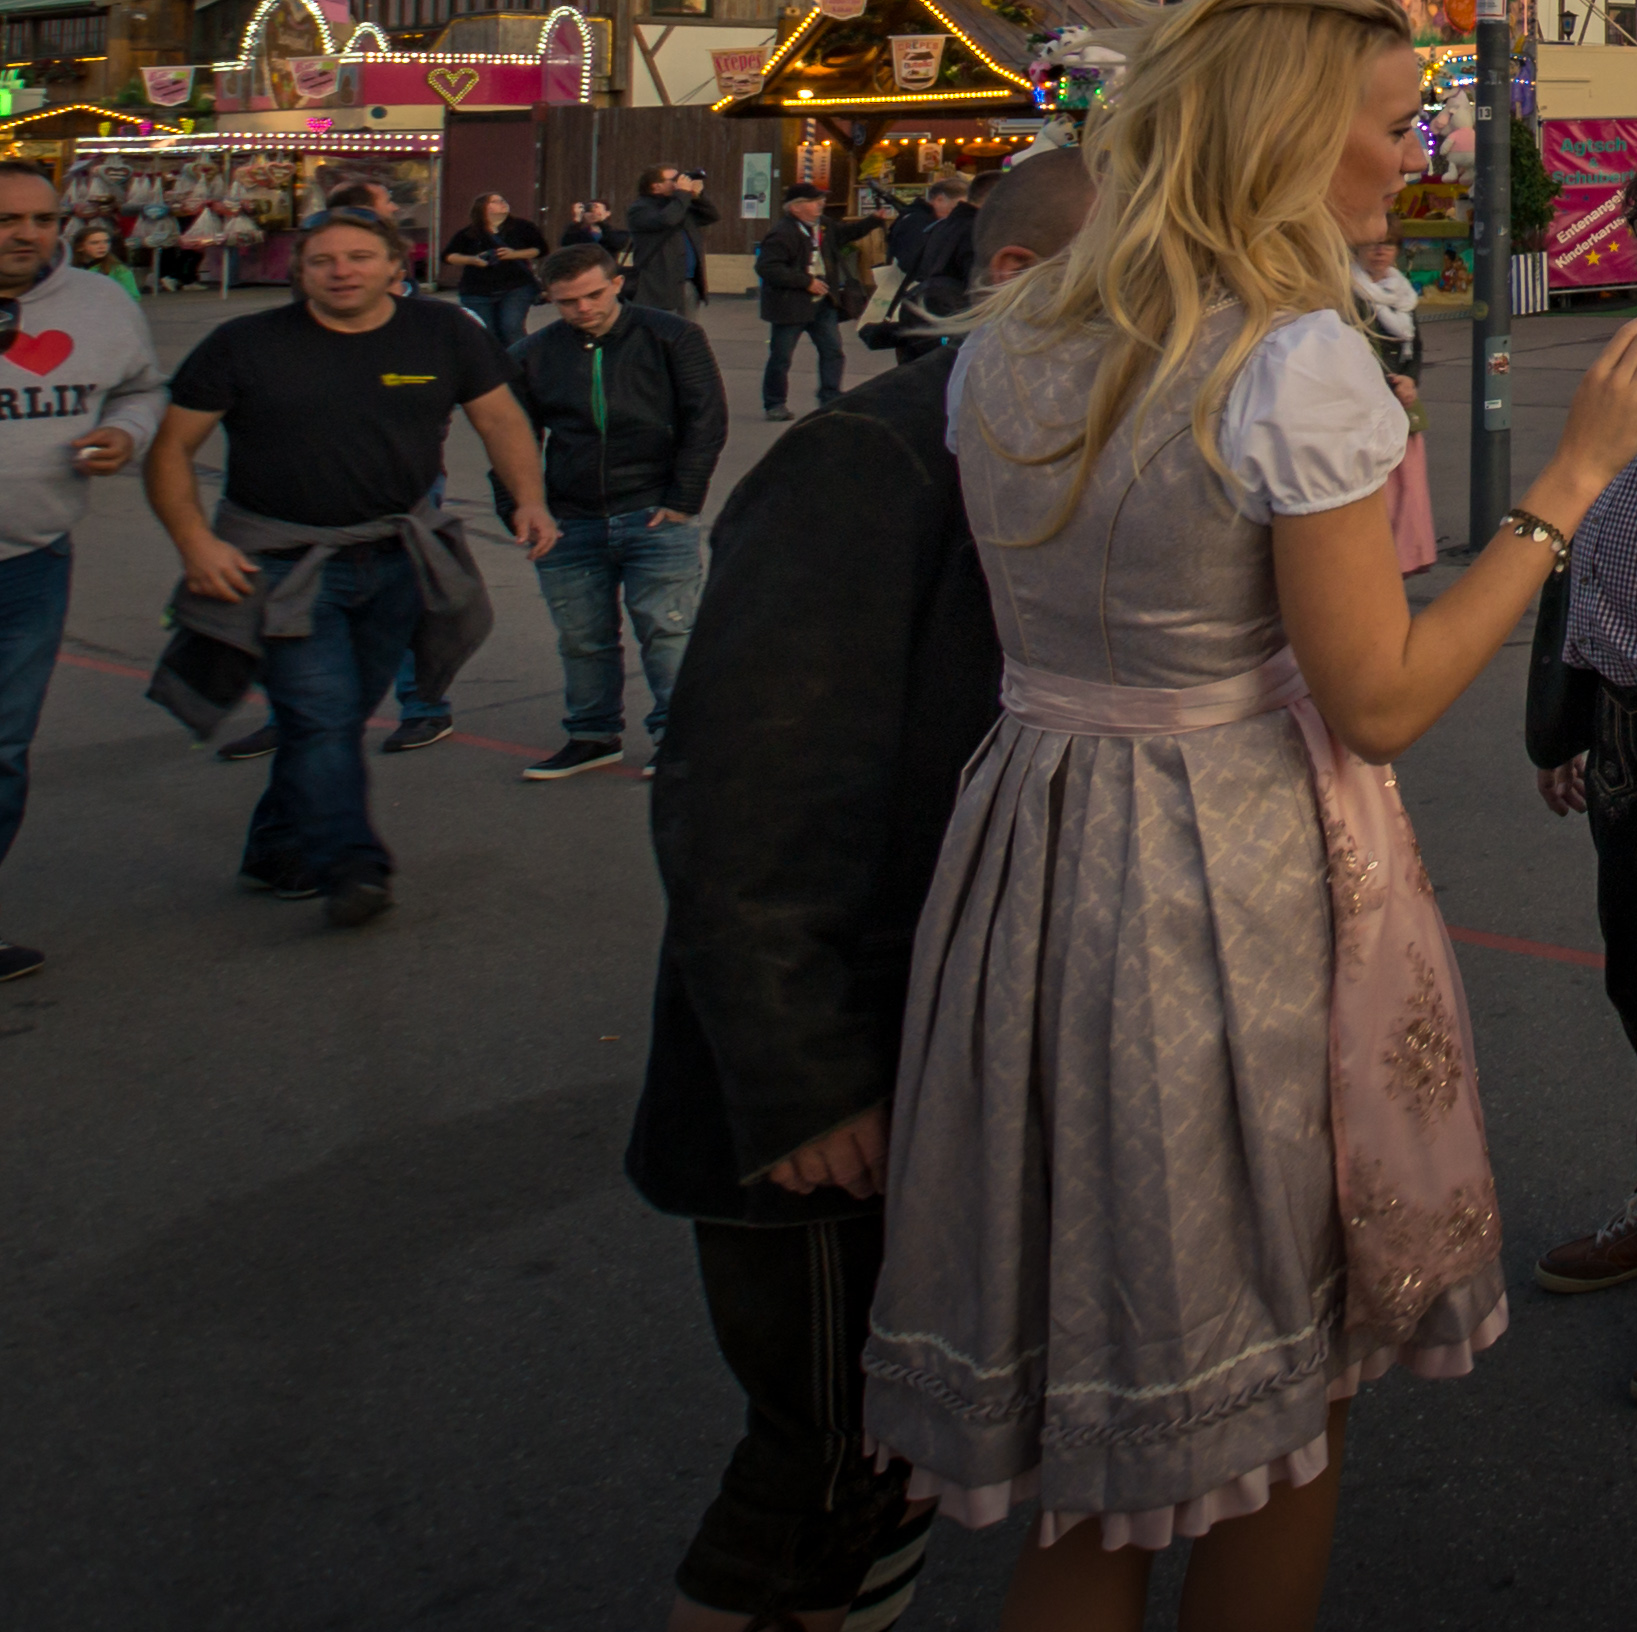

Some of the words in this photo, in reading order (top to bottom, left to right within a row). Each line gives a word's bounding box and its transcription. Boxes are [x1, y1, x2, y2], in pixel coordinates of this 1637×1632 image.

[1480, 108, 1490, 118] 13
[1561, 137, 1627, 156] Agtsch
[1589, 158, 1598, 167] &
[1552, 169, 1635, 185] Schubert
[1555, 214, 1627, 268] Kinderkarus
